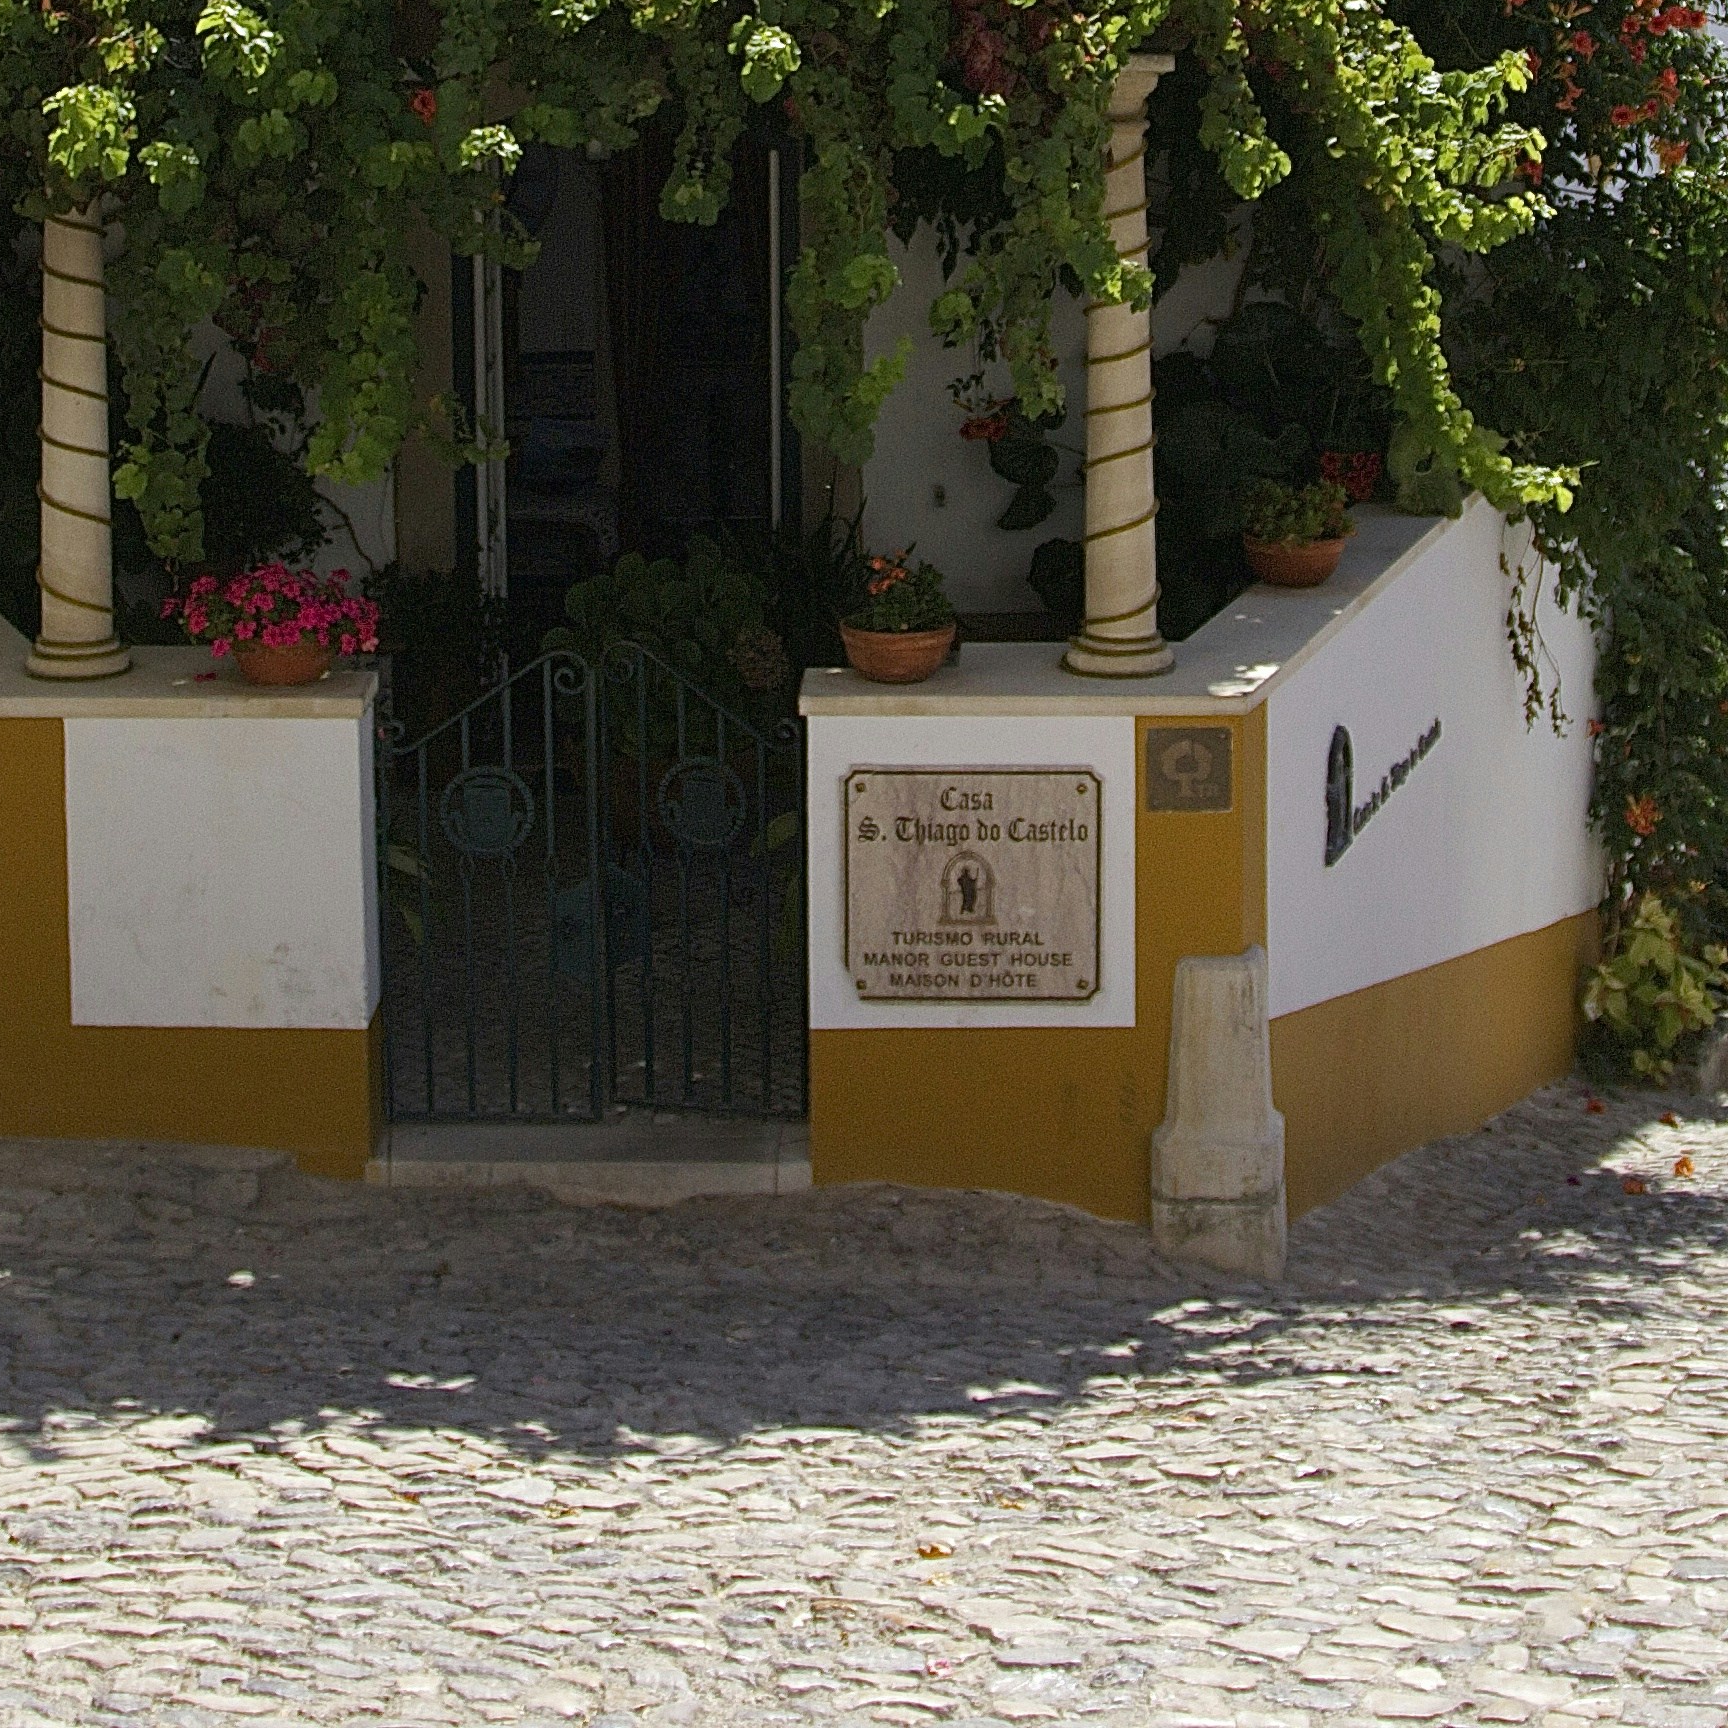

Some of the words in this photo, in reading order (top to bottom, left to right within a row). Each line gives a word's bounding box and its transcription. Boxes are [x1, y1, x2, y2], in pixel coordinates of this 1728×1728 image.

[940, 786, 993, 812] Casa
[858, 815, 887, 842] S.
[895, 816, 970, 846] Thiago
[977, 817, 1000, 841] do
[1008, 816, 1088, 842] Castelo
[891, 931, 973, 946] TURISMO
[982, 931, 1045, 946] RURAL
[863, 952, 930, 967] MANOR
[940, 952, 1000, 967] GUEST
[1010, 952, 1073, 967] HOUSE
[890, 973, 960, 988] MAISON
